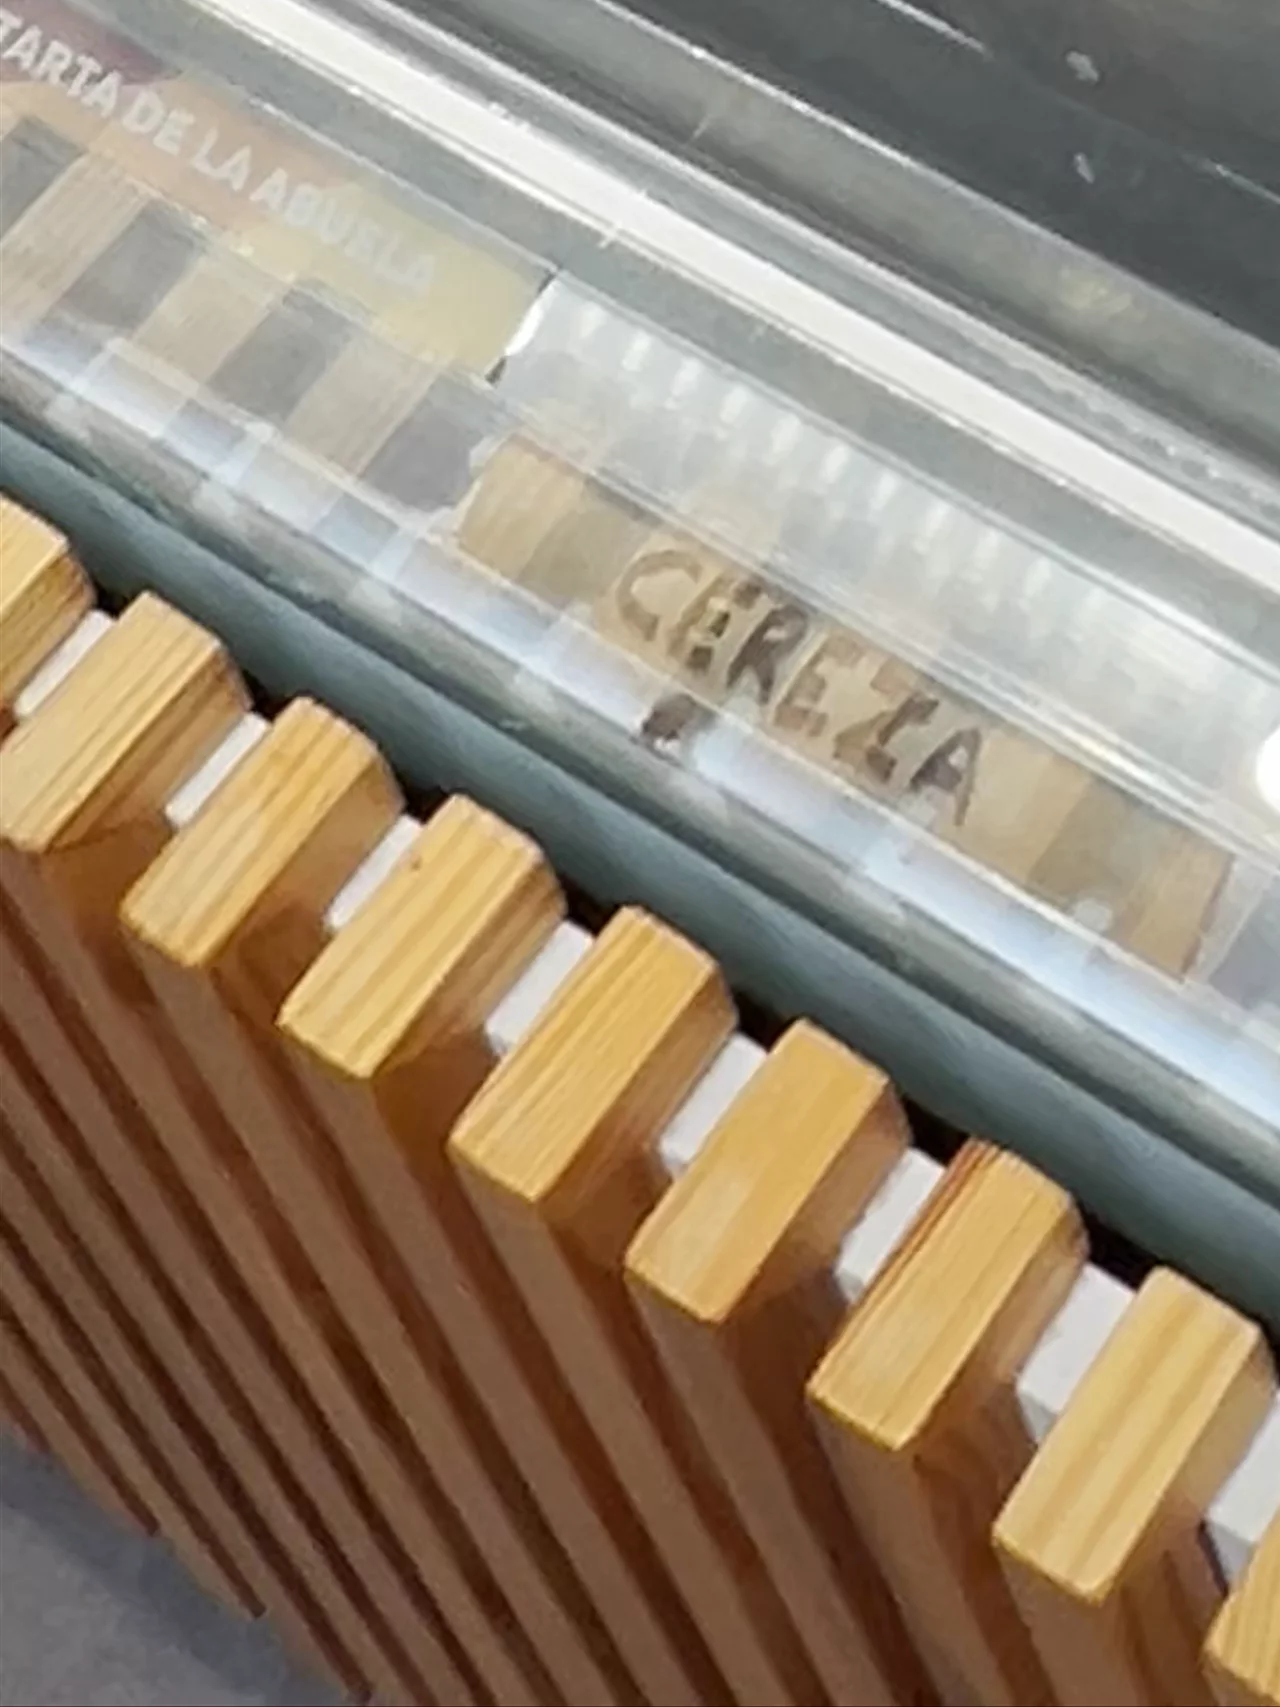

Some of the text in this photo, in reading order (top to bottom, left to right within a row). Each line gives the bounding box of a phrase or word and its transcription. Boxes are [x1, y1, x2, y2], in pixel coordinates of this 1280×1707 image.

[0, 6, 437, 301] TARTA DE LA ABUELA
[614, 548, 983, 828] CEREZA
